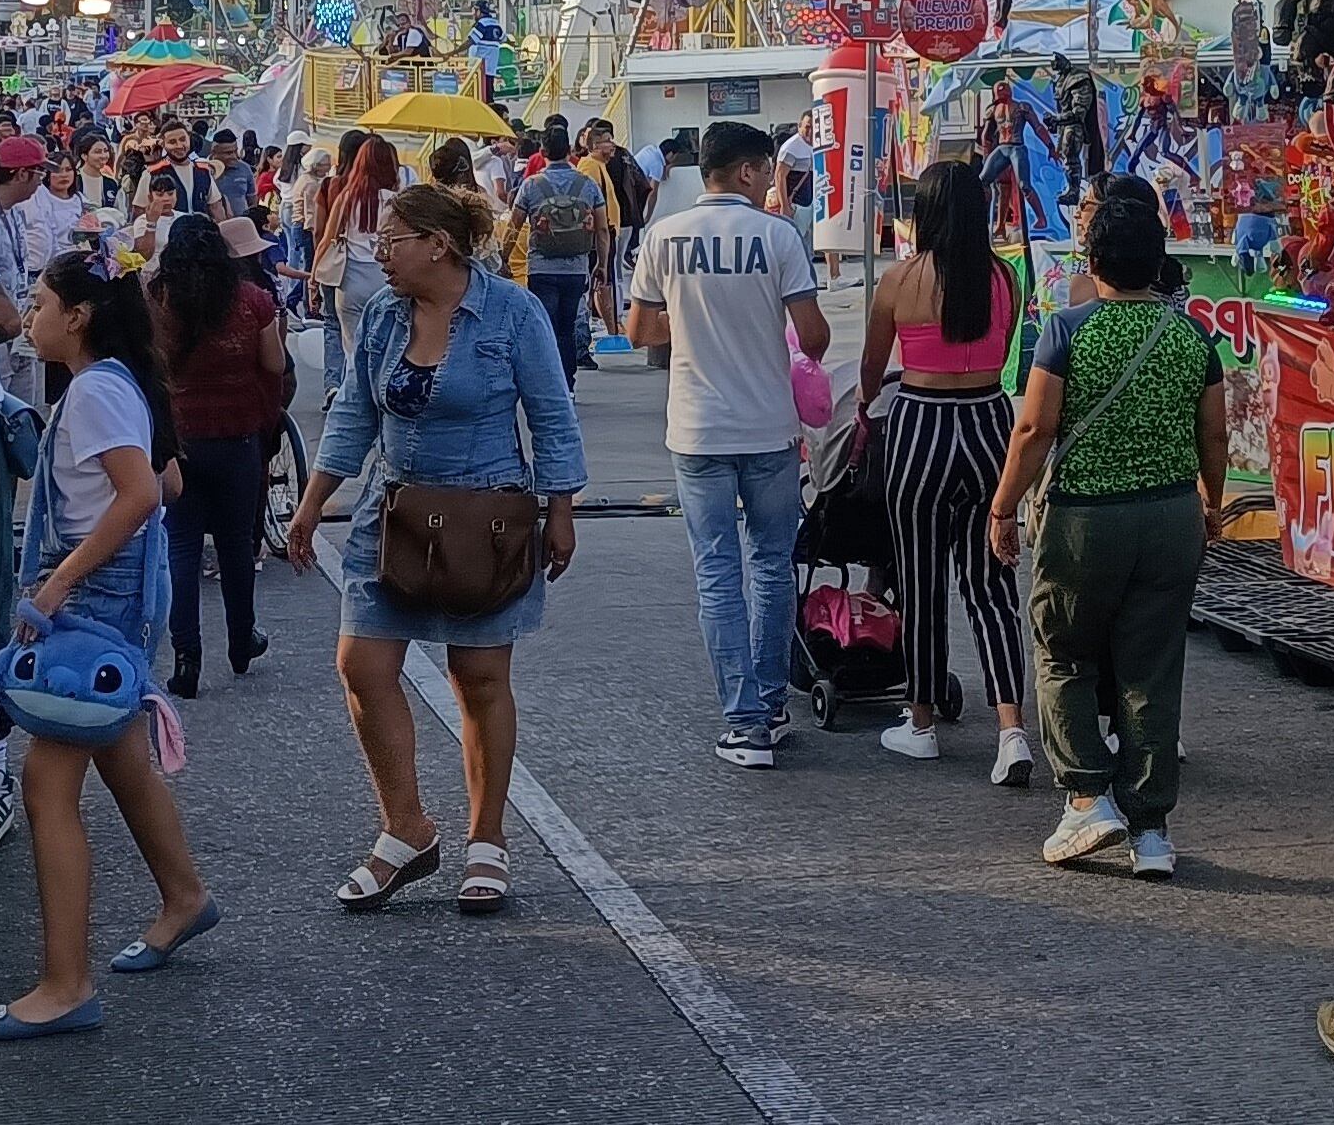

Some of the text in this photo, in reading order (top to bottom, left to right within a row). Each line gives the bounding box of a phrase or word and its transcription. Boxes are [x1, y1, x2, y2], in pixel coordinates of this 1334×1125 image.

[916, 0, 972, 14] LLEVAN
[914, 15, 975, 31] PREMIO
[662, 236, 769, 276] ITALIA
